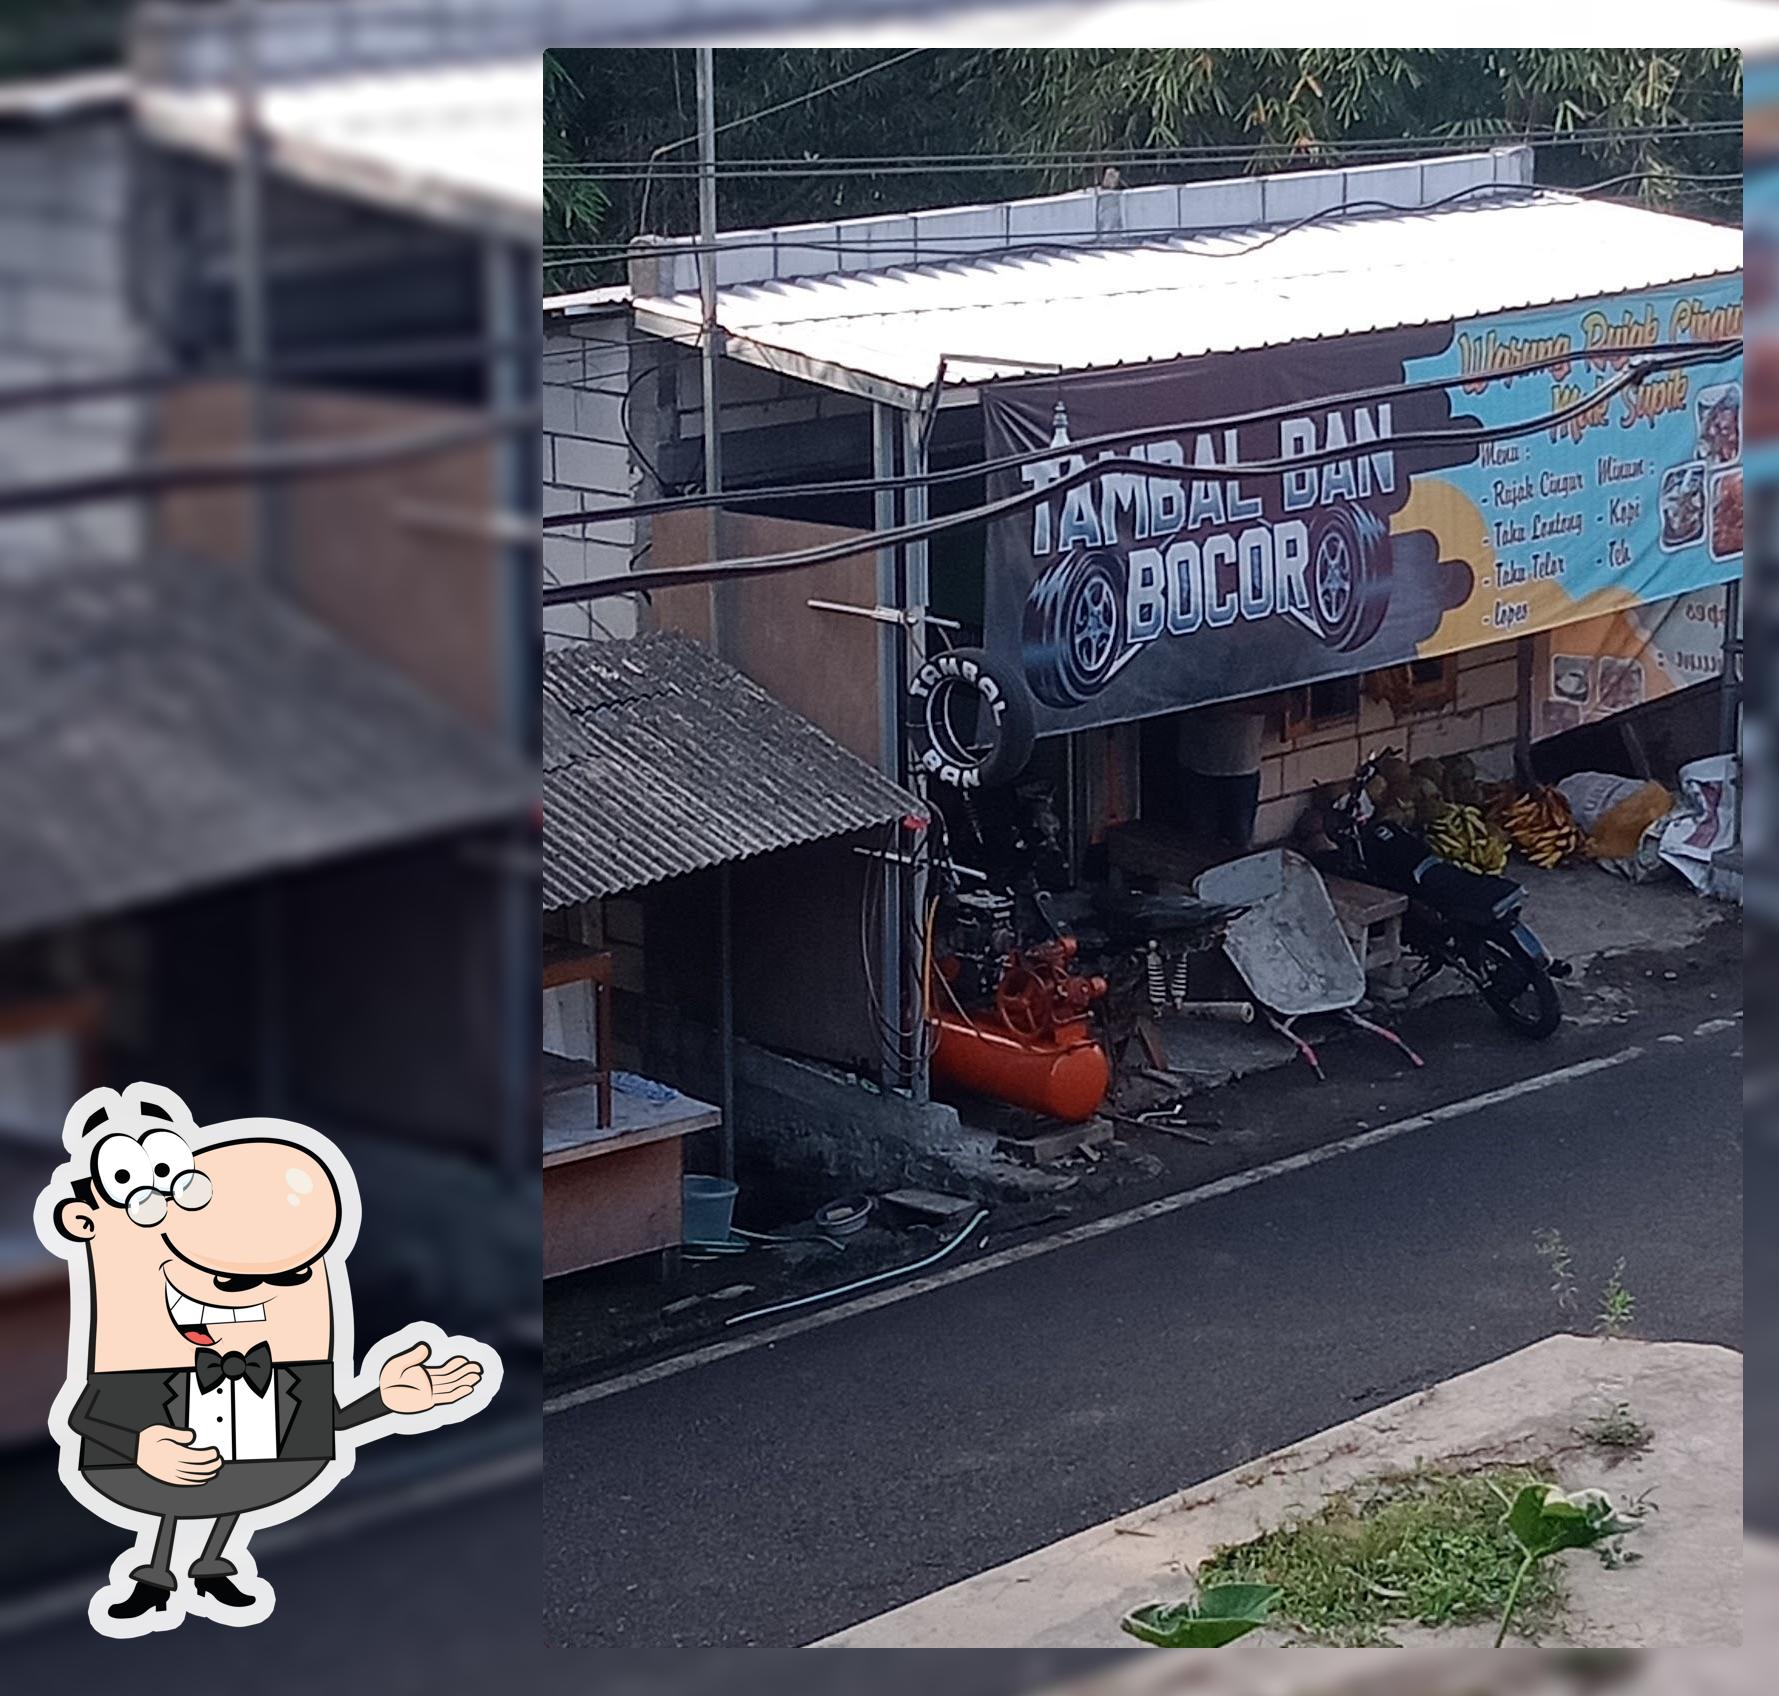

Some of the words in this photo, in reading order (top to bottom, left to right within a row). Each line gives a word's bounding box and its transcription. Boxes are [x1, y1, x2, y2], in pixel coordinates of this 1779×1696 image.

[1458, 329, 1571, 395] Warung
[1669, 297, 1743, 344] Cingu
[1021, 429, 1264, 556] TAMBAL
[1280, 403, 1395, 512] BAN
[1127, 519, 1311, 645] BOCOR
[922, 748, 981, 788] BAN
